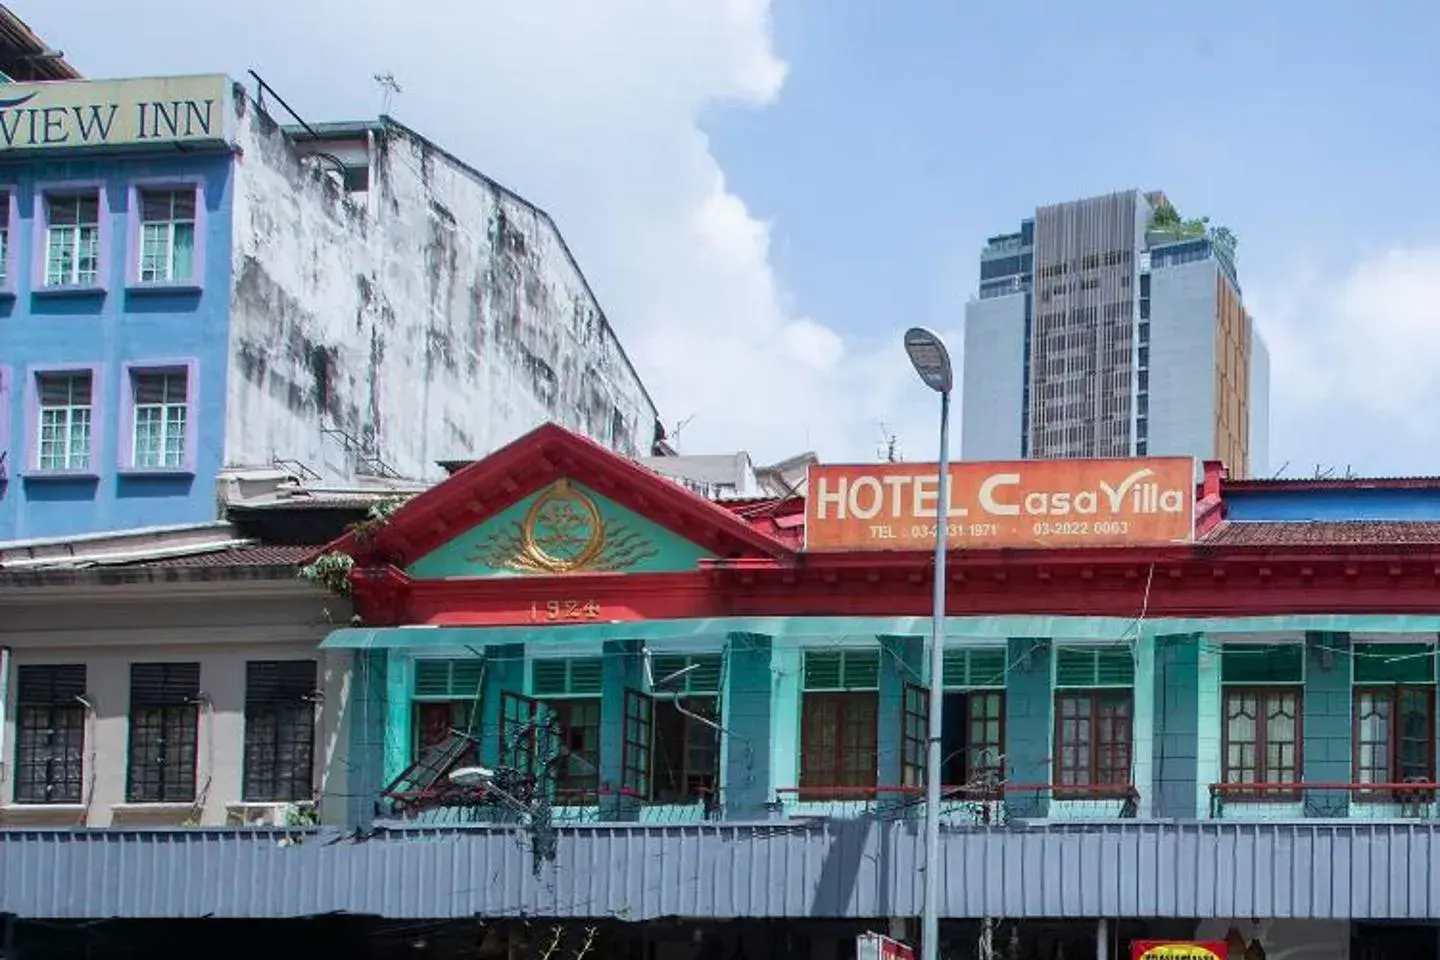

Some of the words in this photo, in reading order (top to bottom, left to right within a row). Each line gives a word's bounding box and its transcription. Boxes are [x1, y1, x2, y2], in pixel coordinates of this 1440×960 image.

[0, 104, 118, 146] VIEW
[136, 100, 214, 139] INN
[817, 473, 968, 519] HOTEL
[529, 600, 600, 619] 1924
